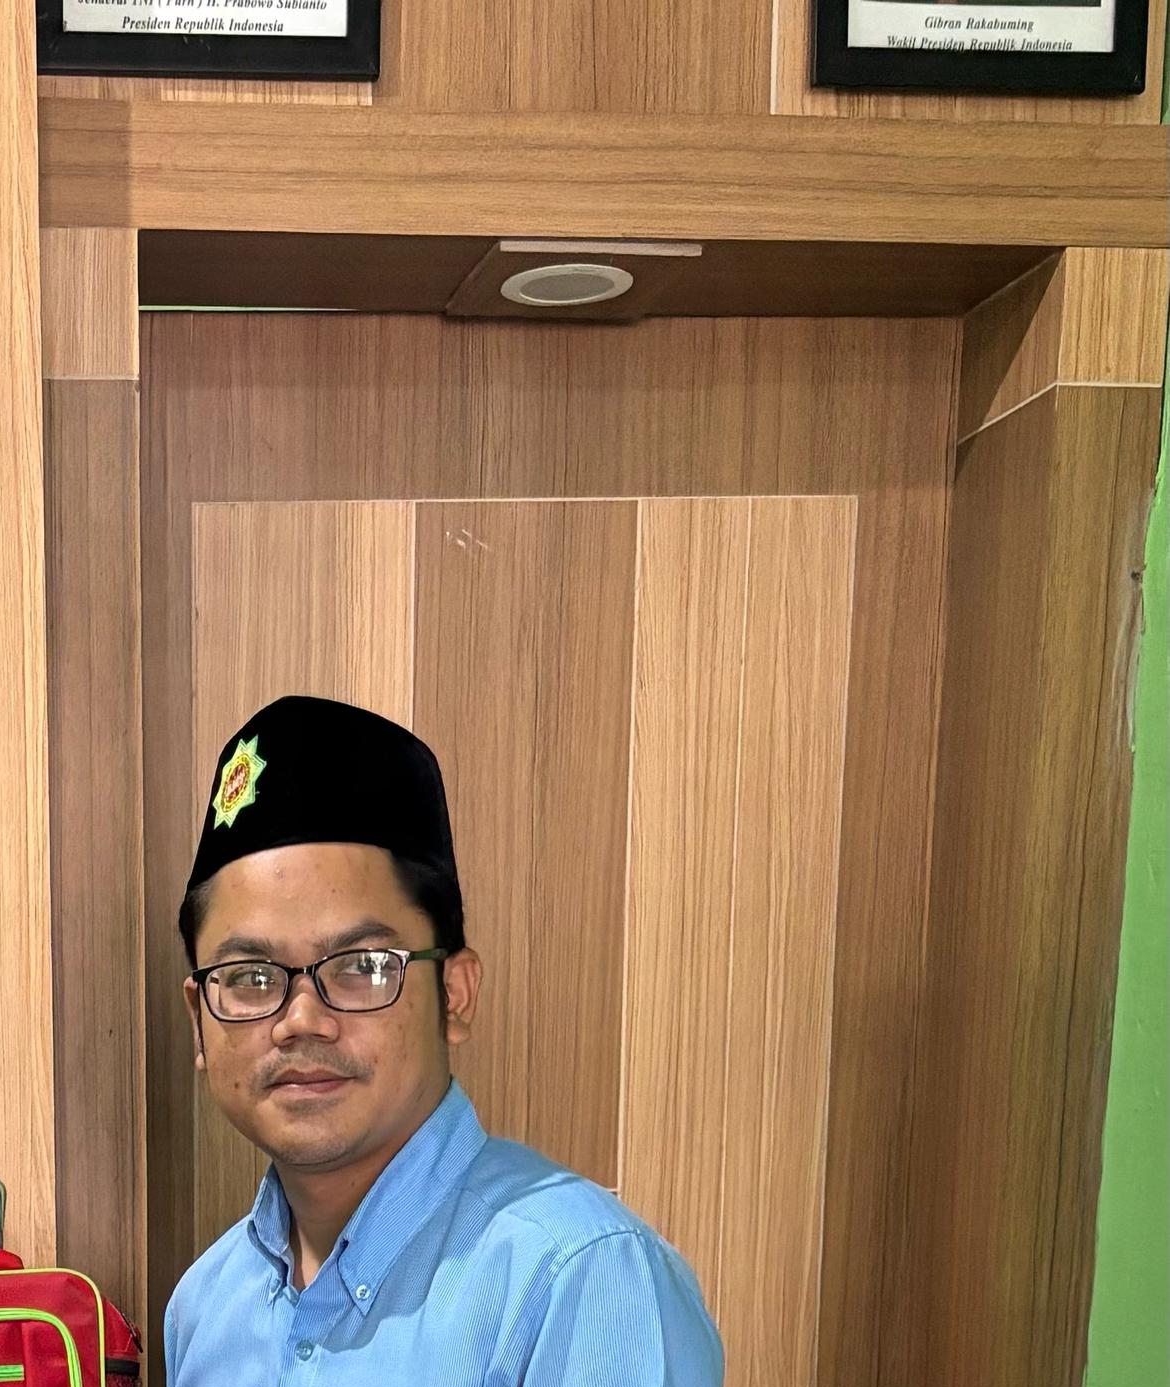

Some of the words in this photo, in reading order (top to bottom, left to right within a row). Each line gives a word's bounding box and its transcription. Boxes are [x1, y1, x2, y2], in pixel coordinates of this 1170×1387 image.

[121, 16, 170, 30] Presiden
[175, 17, 225, 33] Republik
[229, 18, 284, 32] Indonesia
[924, 16, 961, 30] Gibran
[966, 17, 1034, 32] Rakabuming
[887, 35, 916, 49] Wakil
[921, 37, 964, 51] Presiden
[970, 38, 1016, 51] Republik
[1021, 39, 1073, 51] Indonesia
